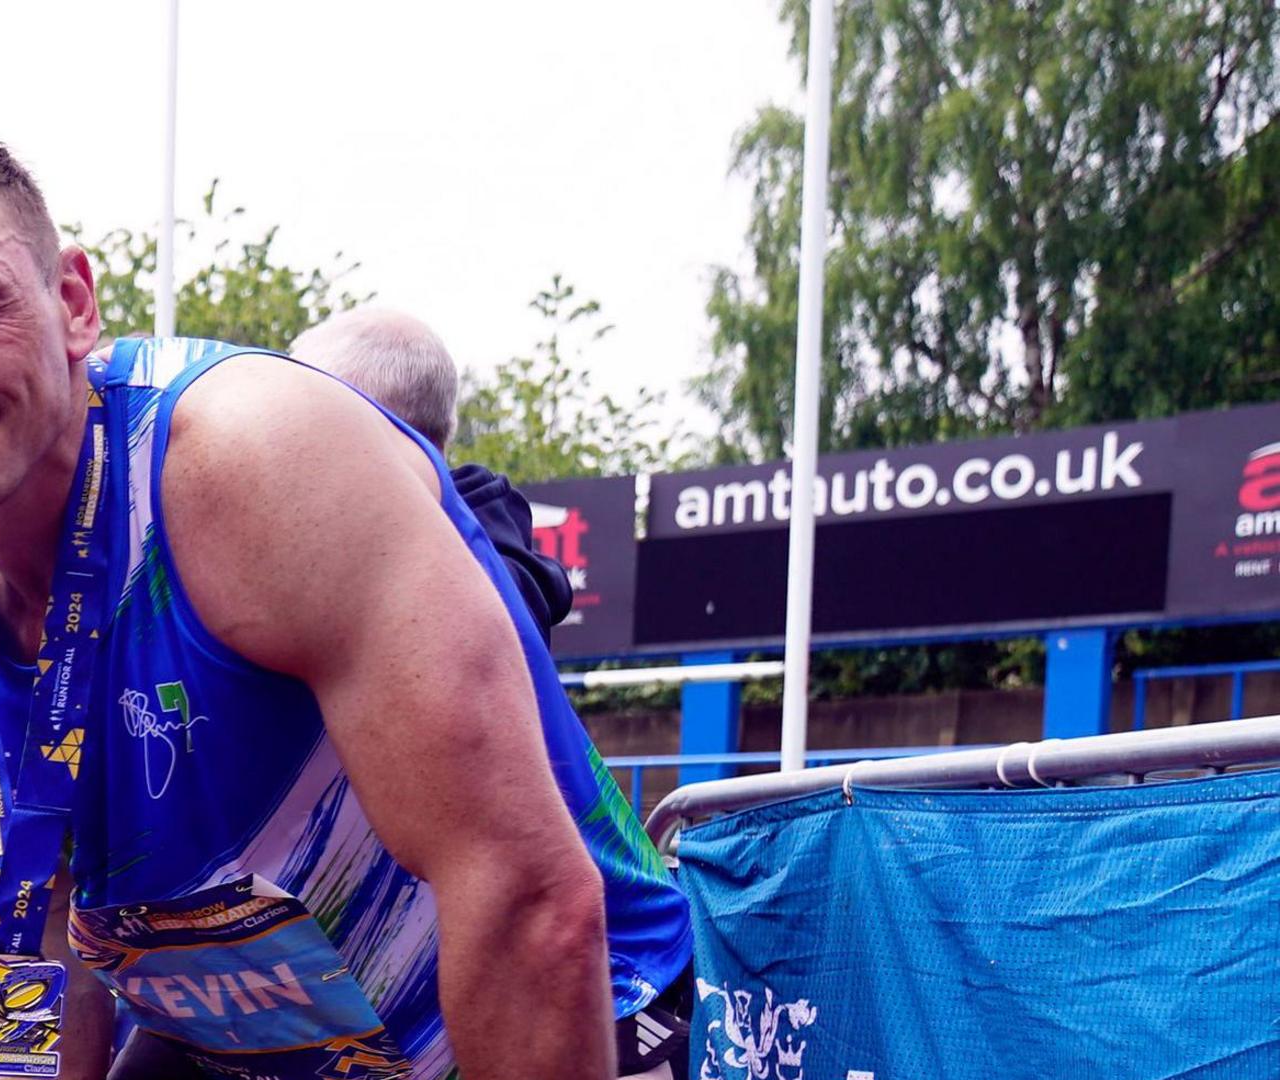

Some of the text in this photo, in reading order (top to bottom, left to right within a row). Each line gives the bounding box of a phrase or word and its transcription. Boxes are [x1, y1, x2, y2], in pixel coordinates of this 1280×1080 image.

[65, 593, 83, 633] 2024
[13, 880, 34, 919] 2024
[242, 905, 290, 929] Clarion
[24, 1064, 55, 1074] Clarion
